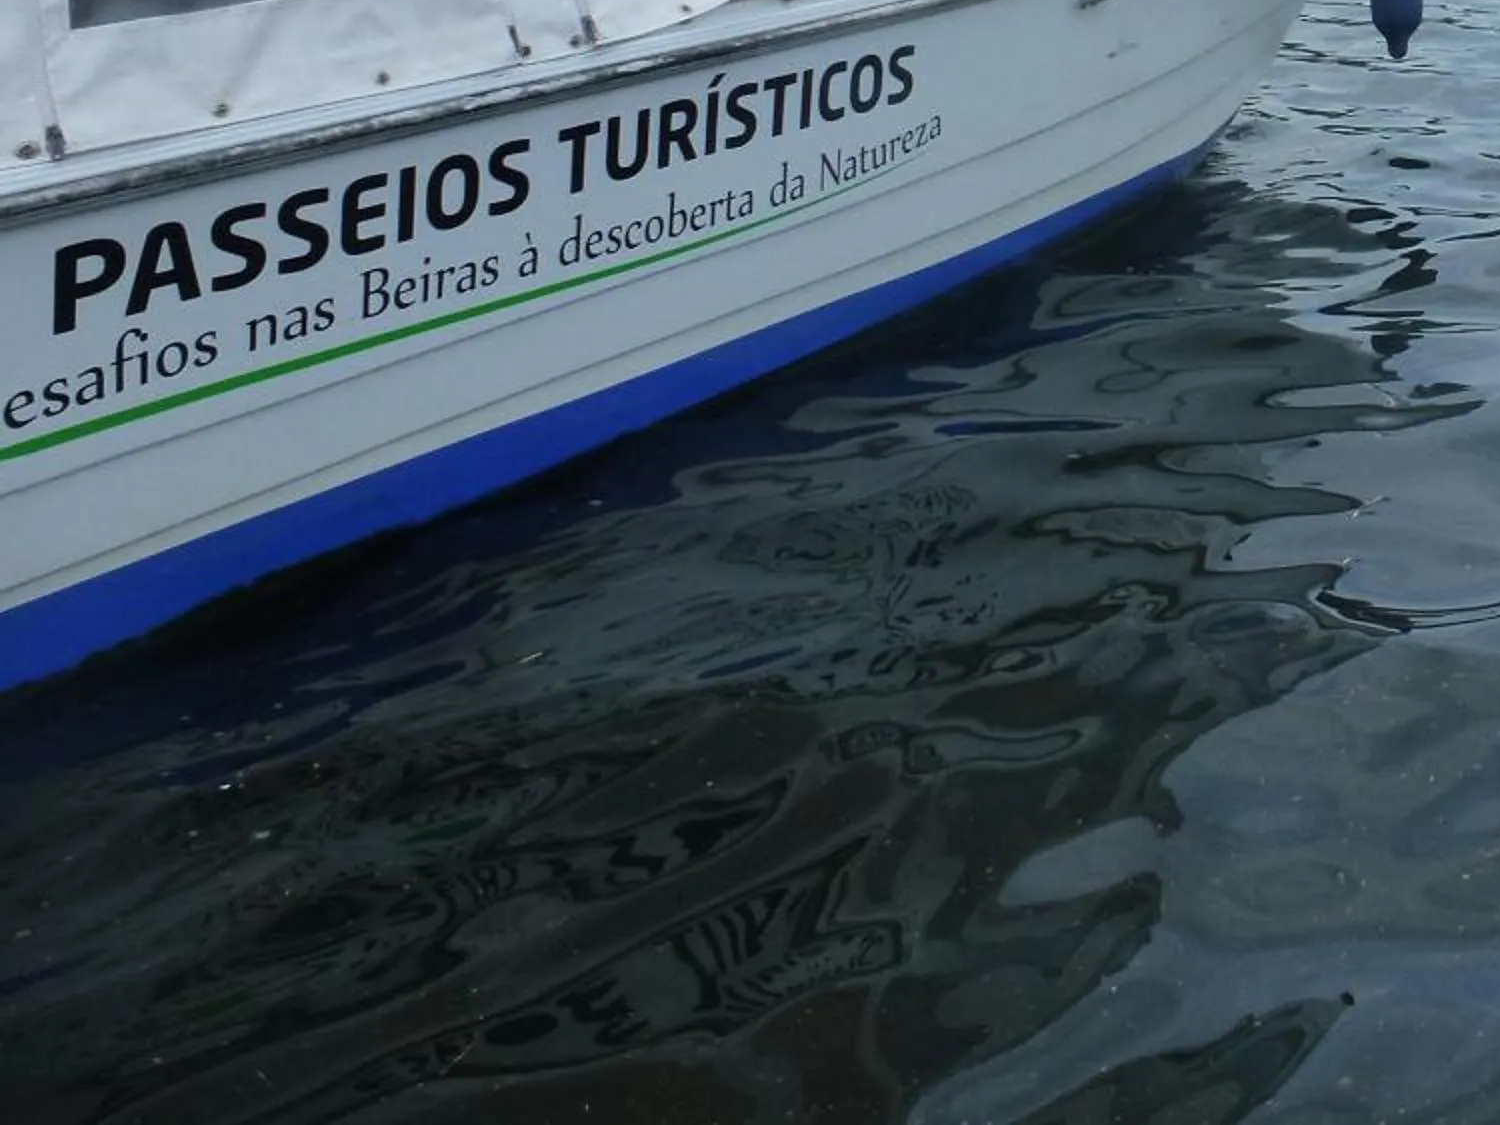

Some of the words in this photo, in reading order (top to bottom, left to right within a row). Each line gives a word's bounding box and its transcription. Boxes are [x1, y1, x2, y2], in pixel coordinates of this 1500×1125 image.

[2, 328, 219, 429] esafios
[246, 296, 336, 351] nas
[360, 253, 500, 318] Beiras
[518, 232, 539, 278] à
[558, 192, 754, 268] descoberta
[769, 162, 806, 207] da
[819, 114, 943, 193] Natureza
[53, 138, 531, 335] PASSEIOS
[558, 45, 916, 194] TURÍSTICOS
